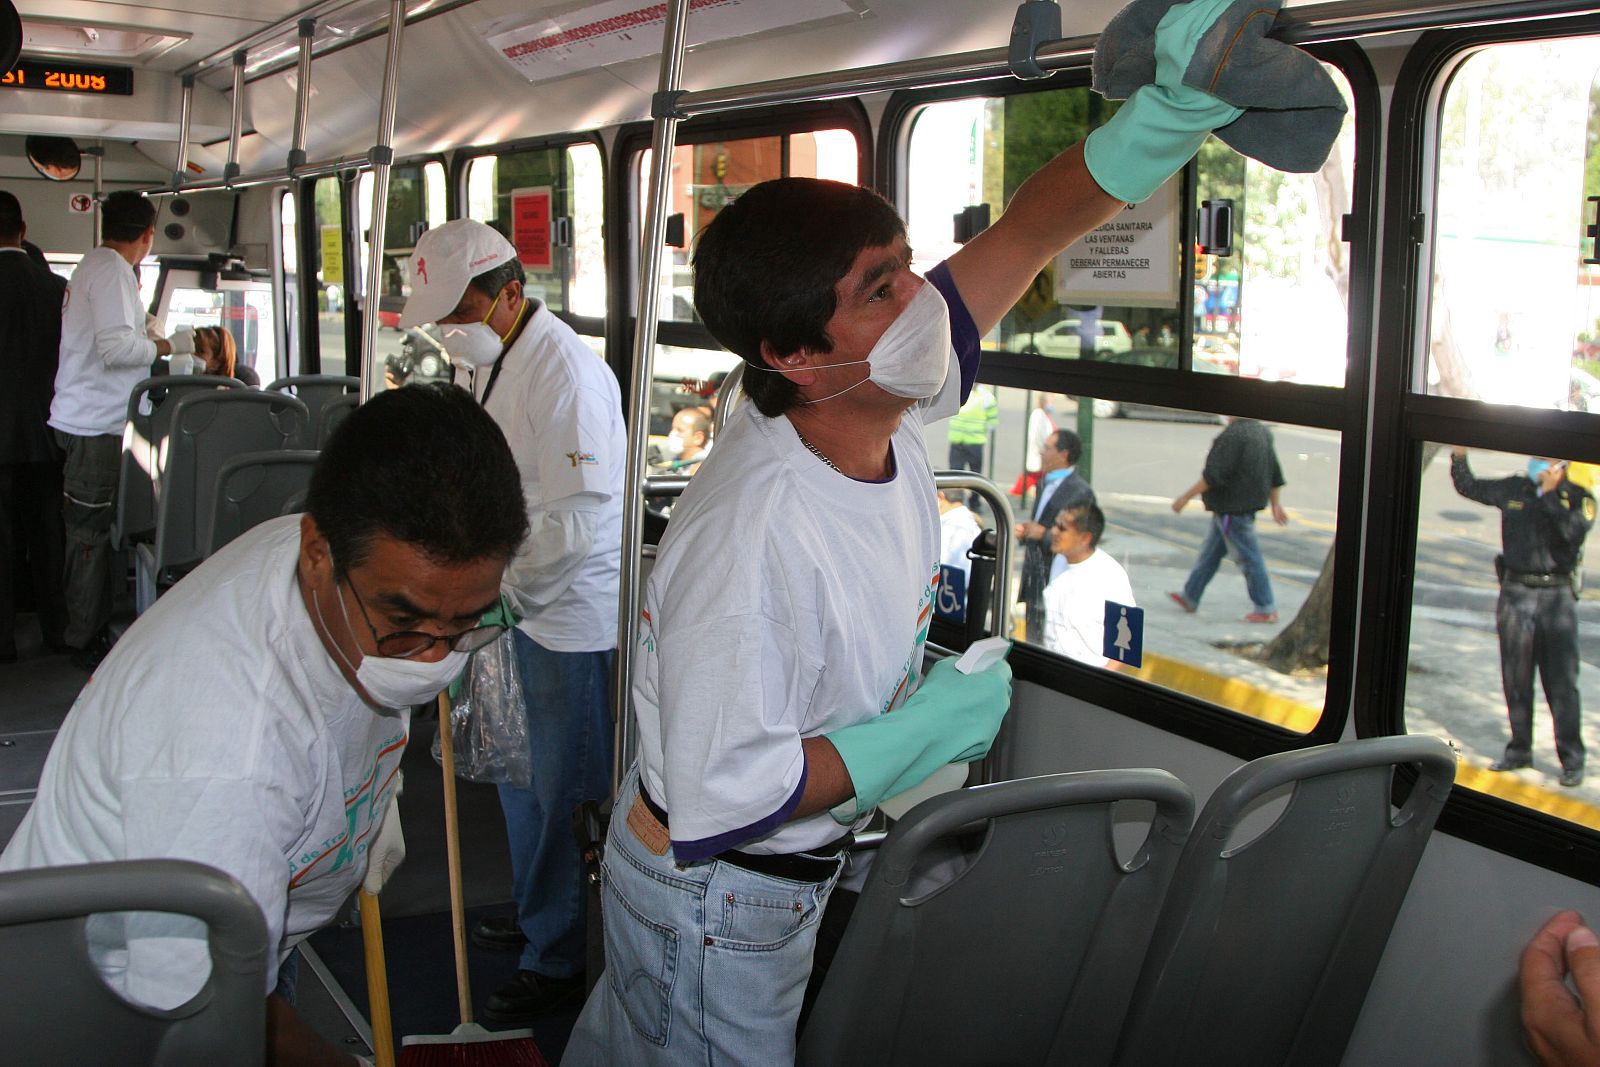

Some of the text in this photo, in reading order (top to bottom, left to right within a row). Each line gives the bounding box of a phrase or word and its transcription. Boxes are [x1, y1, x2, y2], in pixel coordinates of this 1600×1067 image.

[44, 71, 106, 91] 2008
[1116, 222, 1153, 231] SANITARIA
[1085, 235, 1135, 244] LAS VENTANAS
[1095, 246, 1129, 255] FALLEBAS
[1070, 258, 1150, 267] DEBERAN PERMANECER
[1092, 270, 1127, 279] ABIERTAS
[301, 850, 320, 864] de
